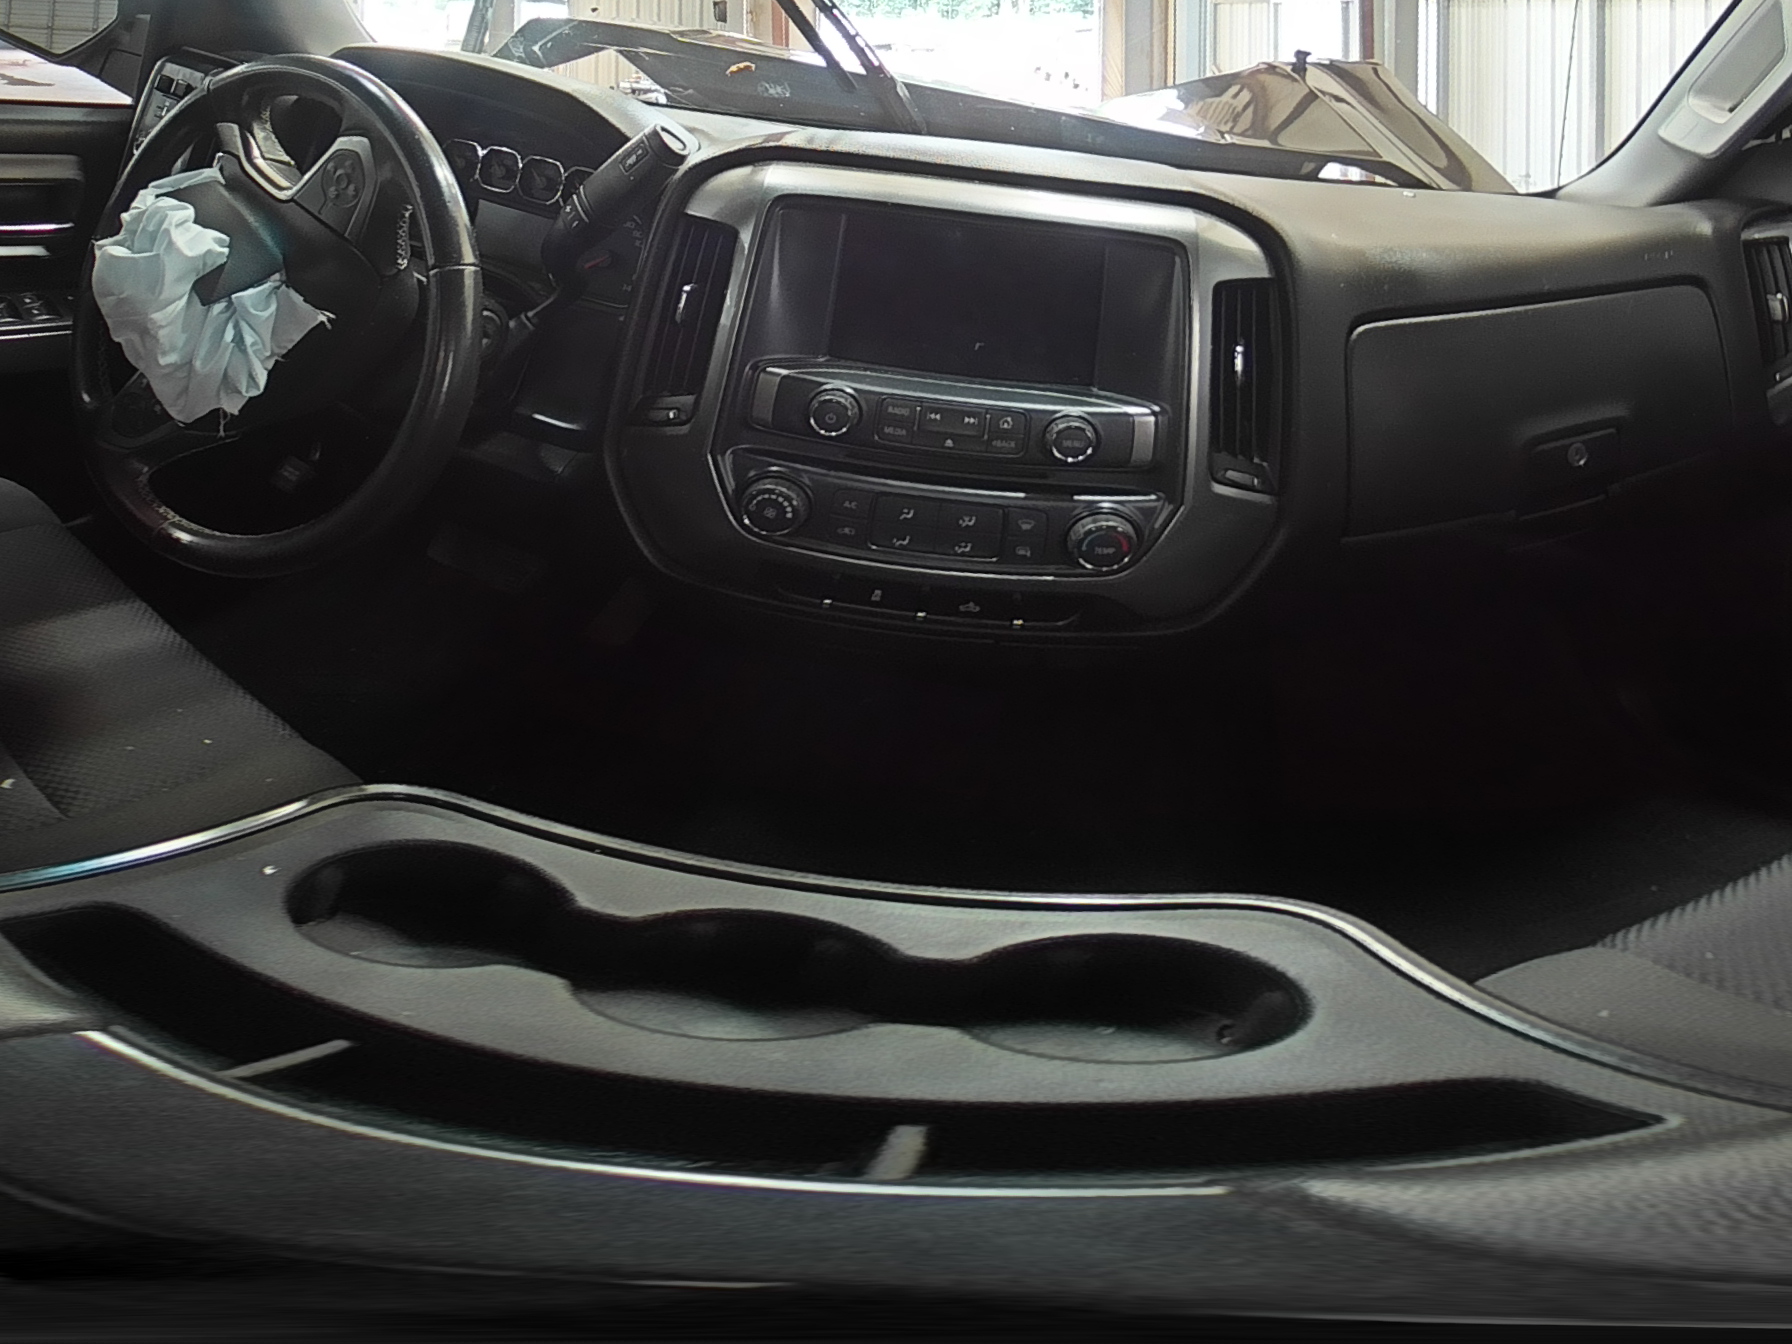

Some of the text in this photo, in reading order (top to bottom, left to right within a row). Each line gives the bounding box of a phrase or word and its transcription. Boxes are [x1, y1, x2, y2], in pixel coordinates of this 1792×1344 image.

[887, 405, 910, 417] RADIO
[883, 425, 907, 436] MEDIA
[1062, 439, 1086, 448] MENU
[1094, 546, 1116, 556] TEMP
